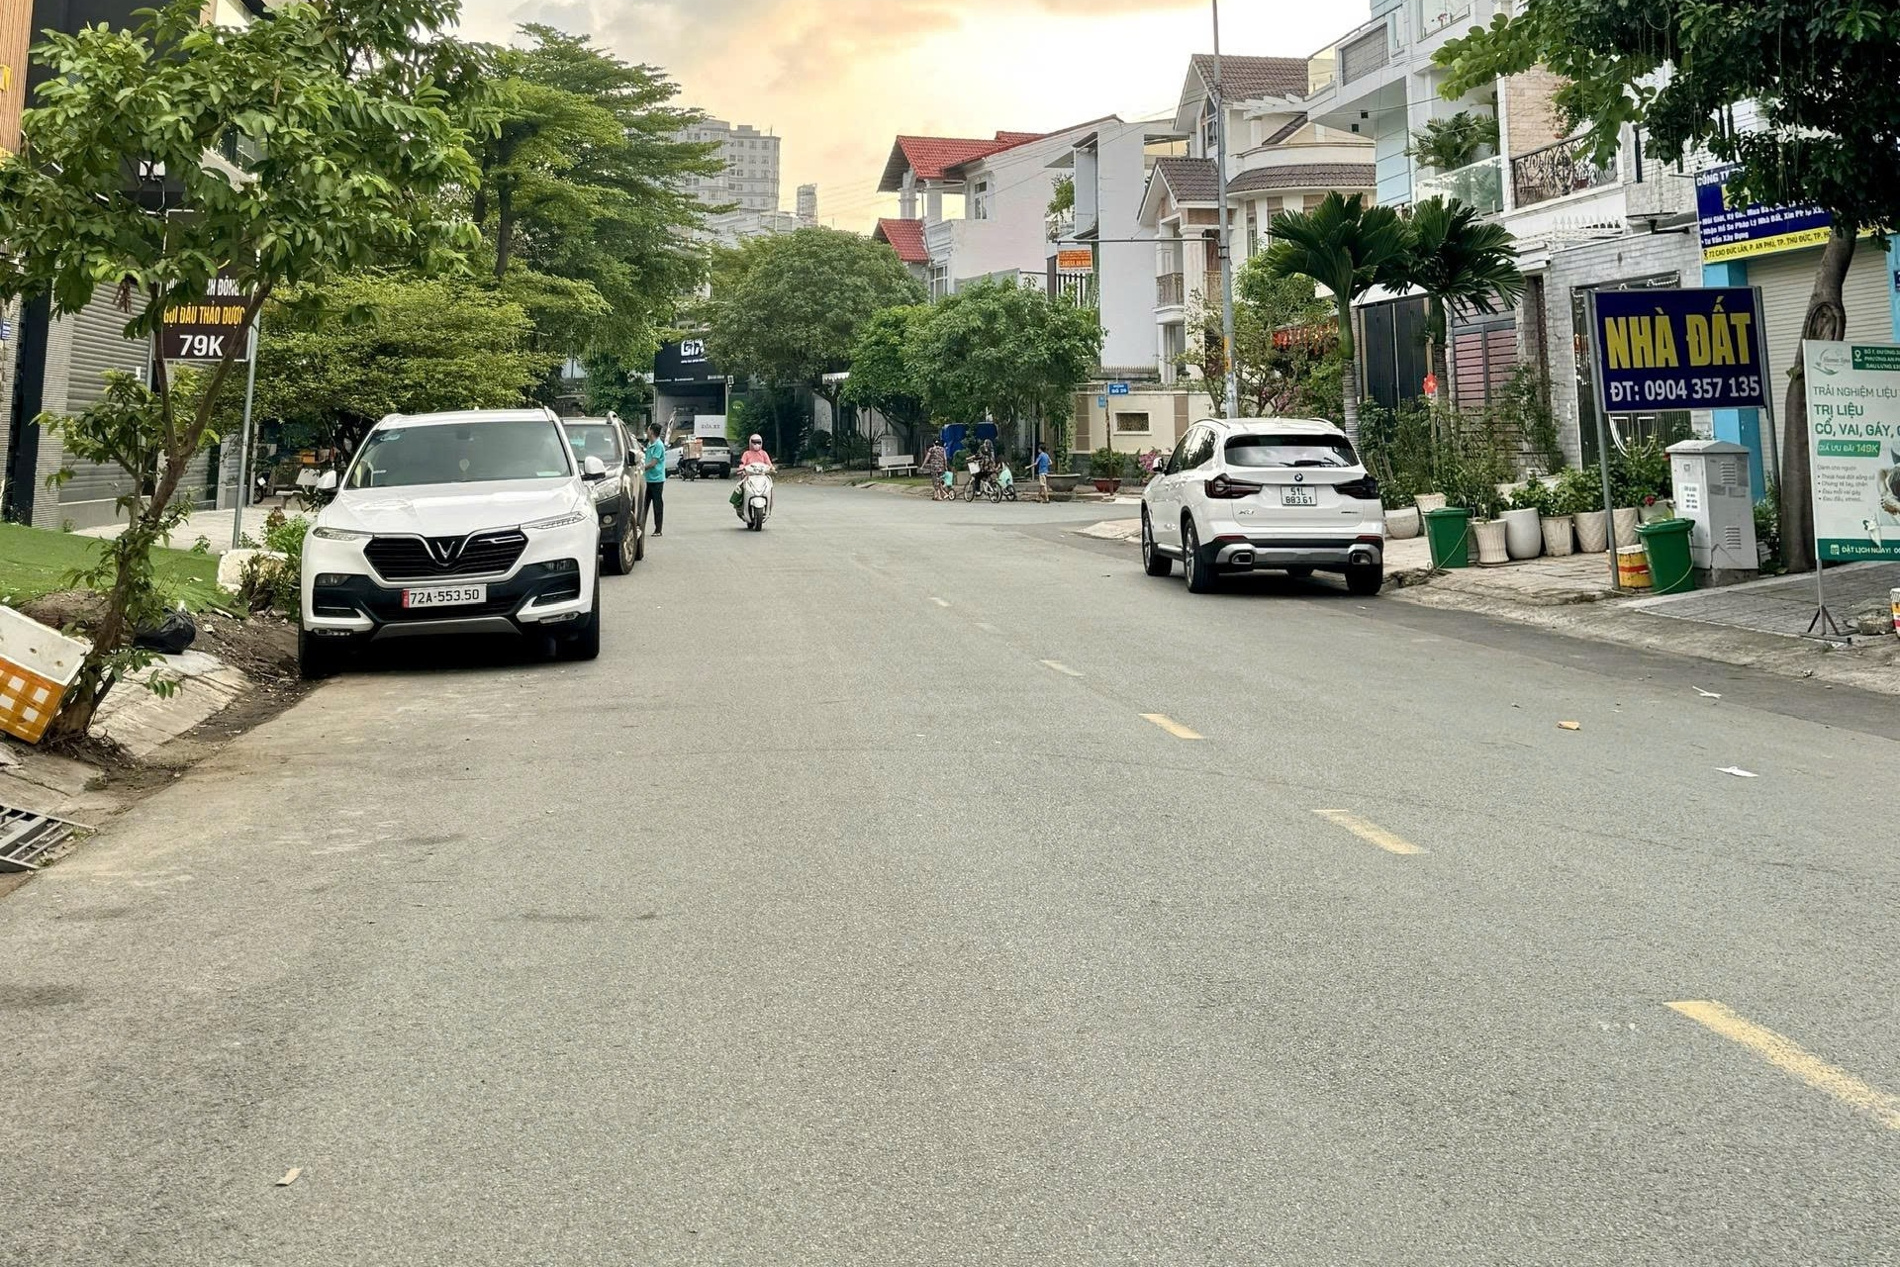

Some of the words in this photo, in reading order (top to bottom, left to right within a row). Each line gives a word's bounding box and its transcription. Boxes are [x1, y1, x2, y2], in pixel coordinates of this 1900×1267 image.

[199, 300, 221, 325] THẢO
[1604, 306, 1680, 370] NHÀ
[1685, 295, 1751, 367] ĐẤT
[179, 334, 225, 357] 79K
[1610, 381, 1640, 402] ĐT:
[1644, 379, 1688, 401] 0904
[1691, 377, 1723, 399] 357
[1728, 375, 1760, 398] 135
[1813, 384, 1835, 396] TRẢI
[1836, 385, 1874, 398] NGHIỆM
[1876, 386, 1898, 399] LIỆU
[1814, 404, 1834, 417] TRỊ
[1837, 402, 1864, 419] LIỆU
[1815, 416, 1836, 437] CỔ,
[1839, 423, 1863, 438] VAI,
[1865, 421, 1894, 439] GÁY,
[1285, 496, 1313, 504] 883.61
[1290, 487, 1307, 496] 51L
[410, 588, 481, 605] 72A-553.50
